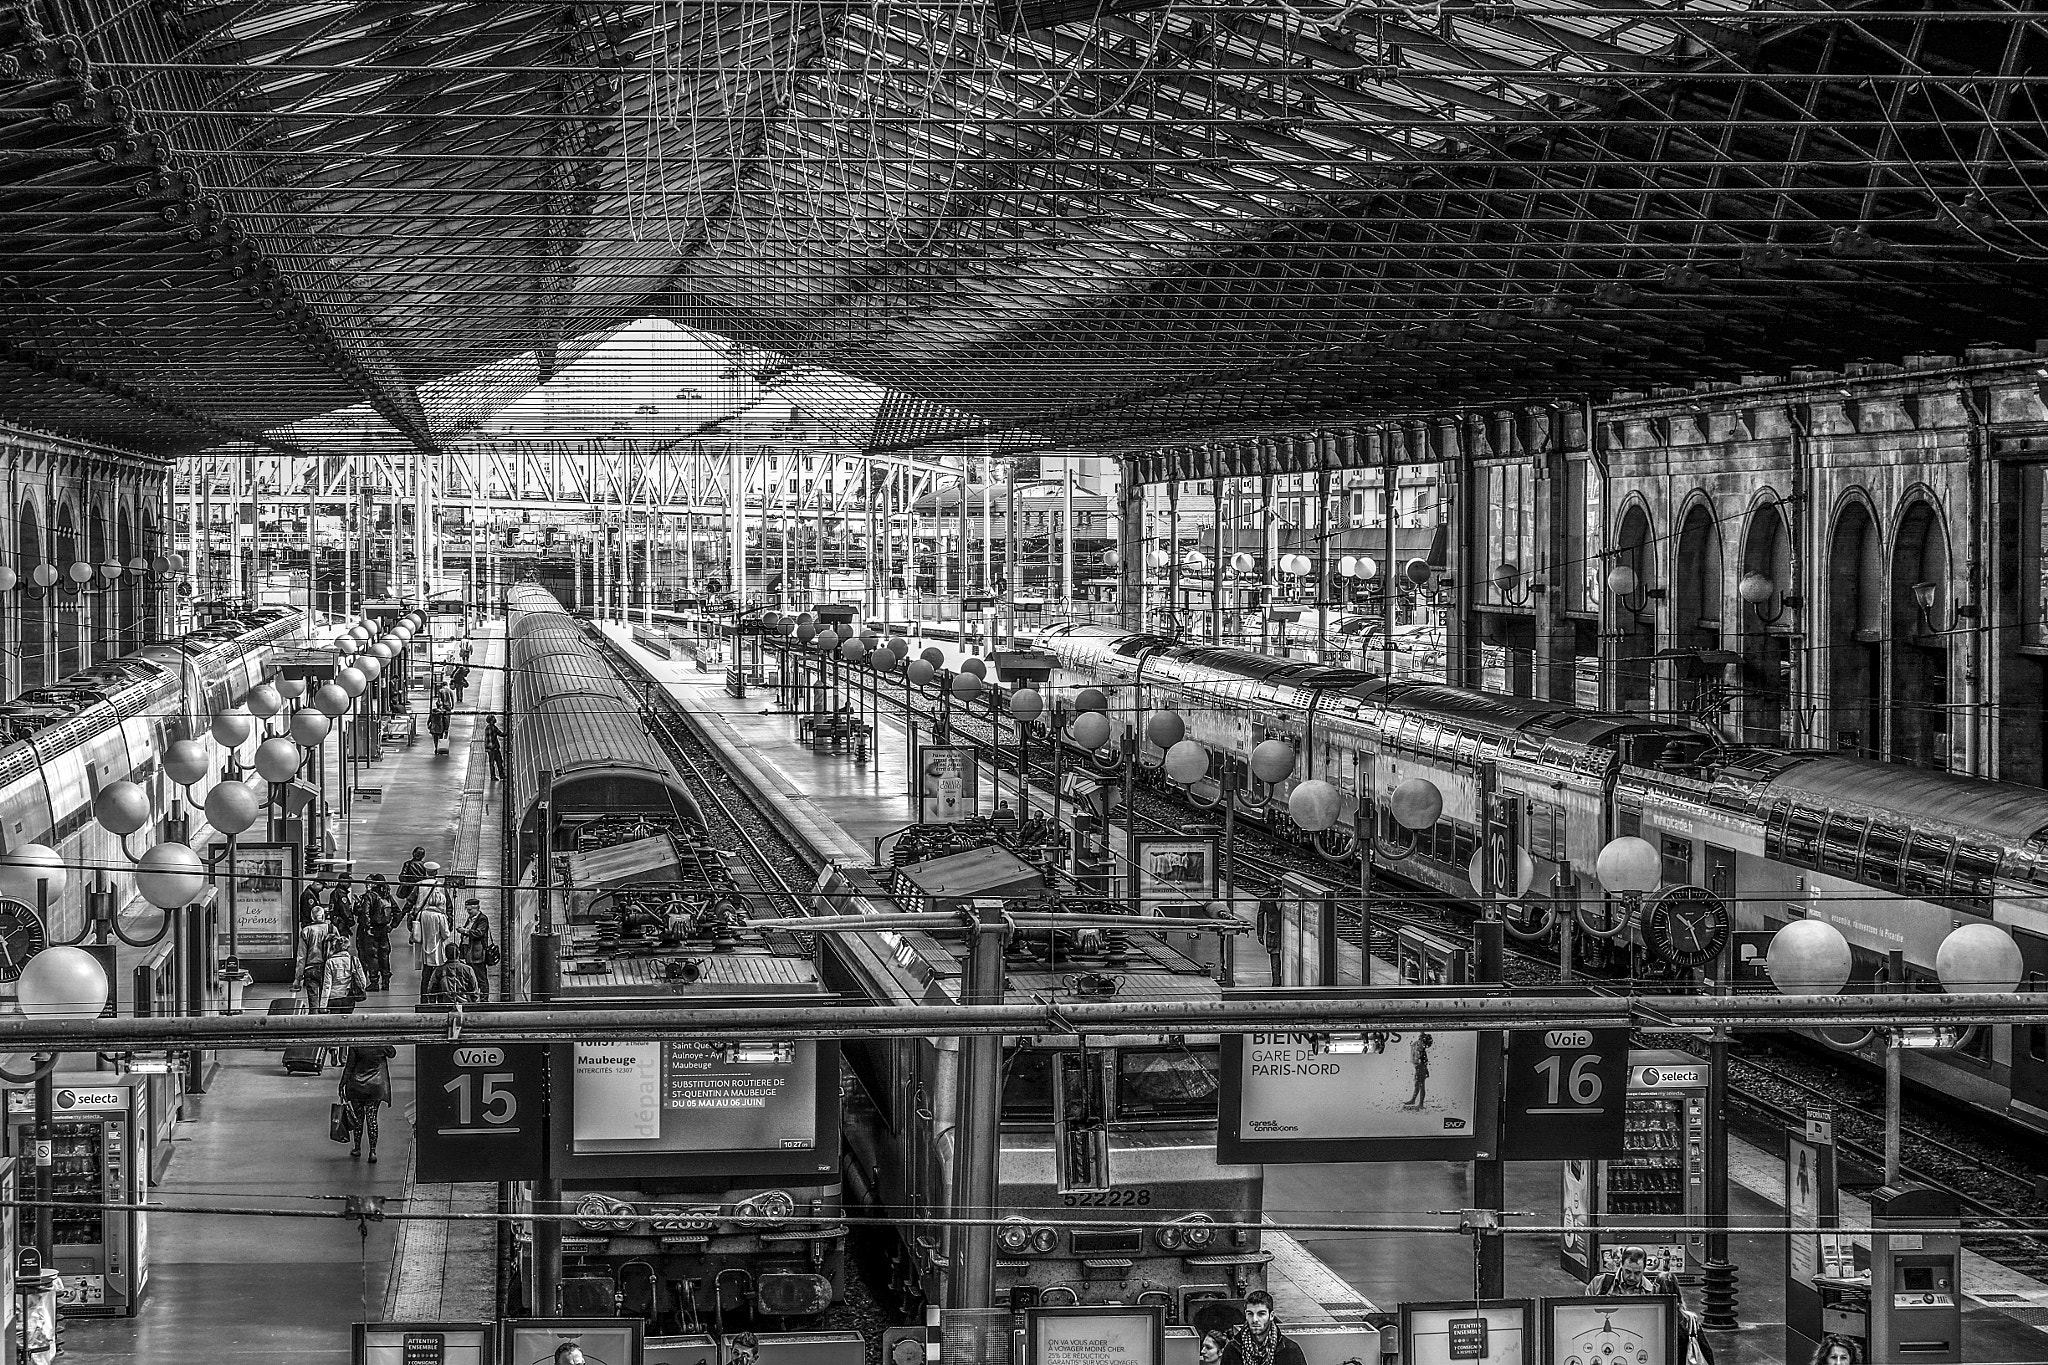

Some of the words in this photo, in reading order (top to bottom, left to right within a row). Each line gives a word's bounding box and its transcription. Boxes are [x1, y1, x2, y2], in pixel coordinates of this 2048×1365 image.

[1491, 832, 1505, 889] 16
[246, 906, 263, 915] Les
[1551, 1032, 1586, 1046] Voie
[672, 1042, 692, 1050] Saint
[459, 1050, 498, 1064] Voie
[577, 1056, 636, 1066] Maubeuge
[672, 1052, 703, 1061] Aulnoye
[1252, 1050, 1291, 1062] GARE
[1296, 1050, 1315, 1061] DE
[672, 1062, 712, 1070] Maubeuge
[1252, 1064, 1340, 1076] PARIS-NORD
[1533, 1054, 1604, 1105] 16
[1661, 1072, 1699, 1081] selecta
[672, 1080, 730, 1089] SUBSTITUTION
[732, 1079, 772, 1087] ROUTIERE
[773, 1078, 785, 1086] DE
[78, 1094, 118, 1104] selecta
[443, 1072, 518, 1124] 15
[633, 1058, 659, 1138] départ
[672, 1090, 722, 1099] ST-QUENTIN
[731, 1088, 777, 1096] MAUBEUGE
[672, 1100, 685, 1108] DU
[687, 1100, 697, 1108] 05
[716, 1099, 729, 1107] AU
[741, 1098, 763, 1106] JUIN
[1064, 1190, 1151, 1206] 522228
